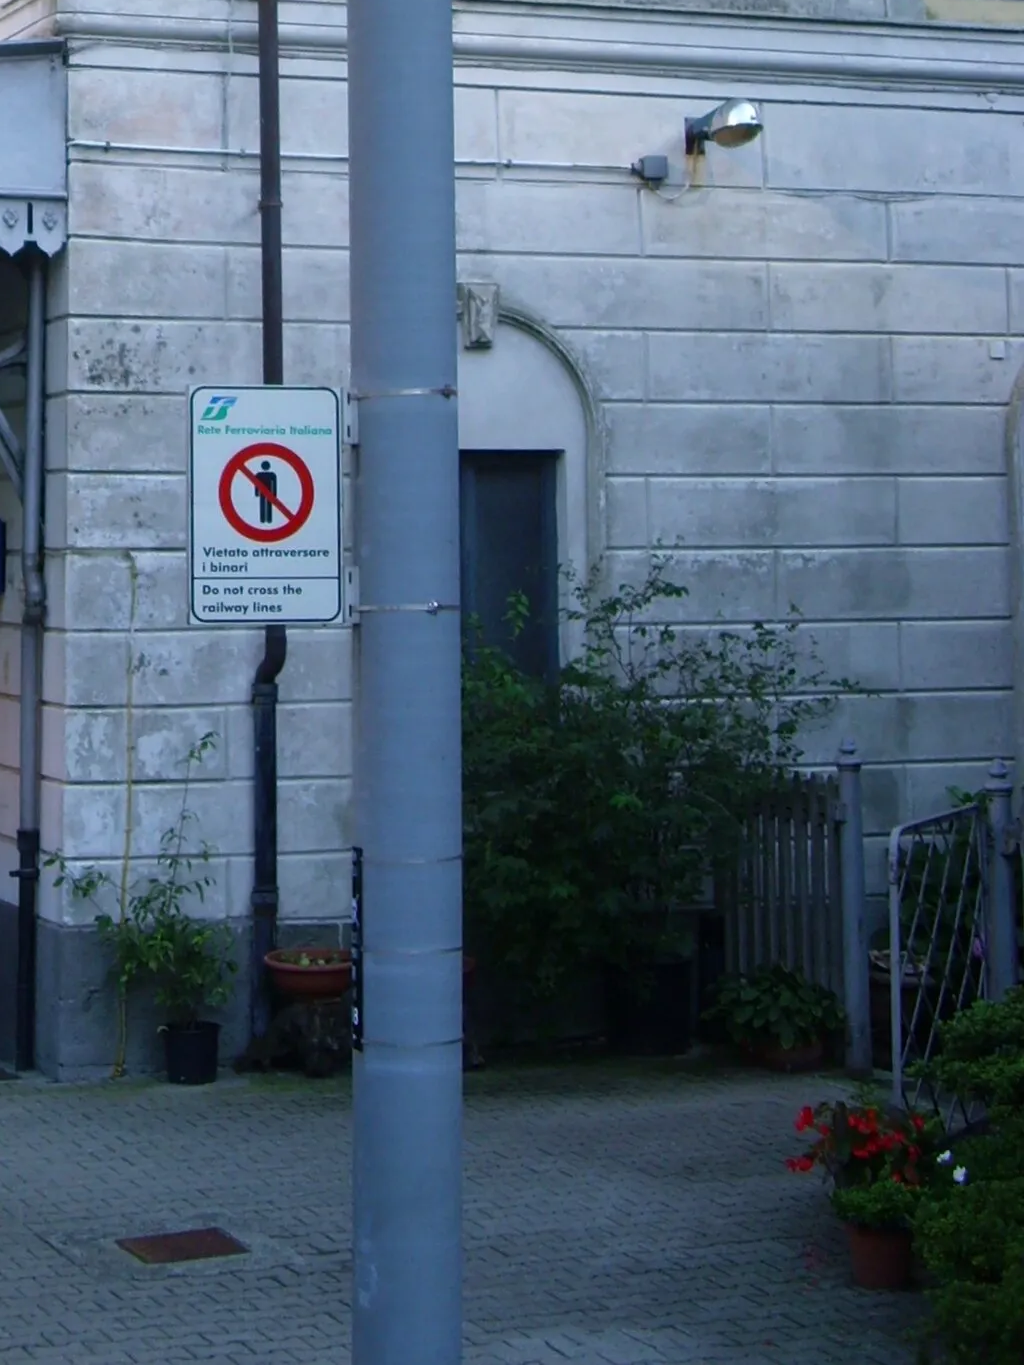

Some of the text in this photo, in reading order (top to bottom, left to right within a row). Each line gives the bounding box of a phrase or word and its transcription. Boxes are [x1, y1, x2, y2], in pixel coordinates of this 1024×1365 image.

[197, 425, 333, 435] Rete Ferroviaria Italiana
[203, 547, 330, 557] Vietato attraversare
[210, 562, 248, 572] binari
[202, 584, 303, 595] Do not cross the
[202, 602, 282, 614] railway lines
